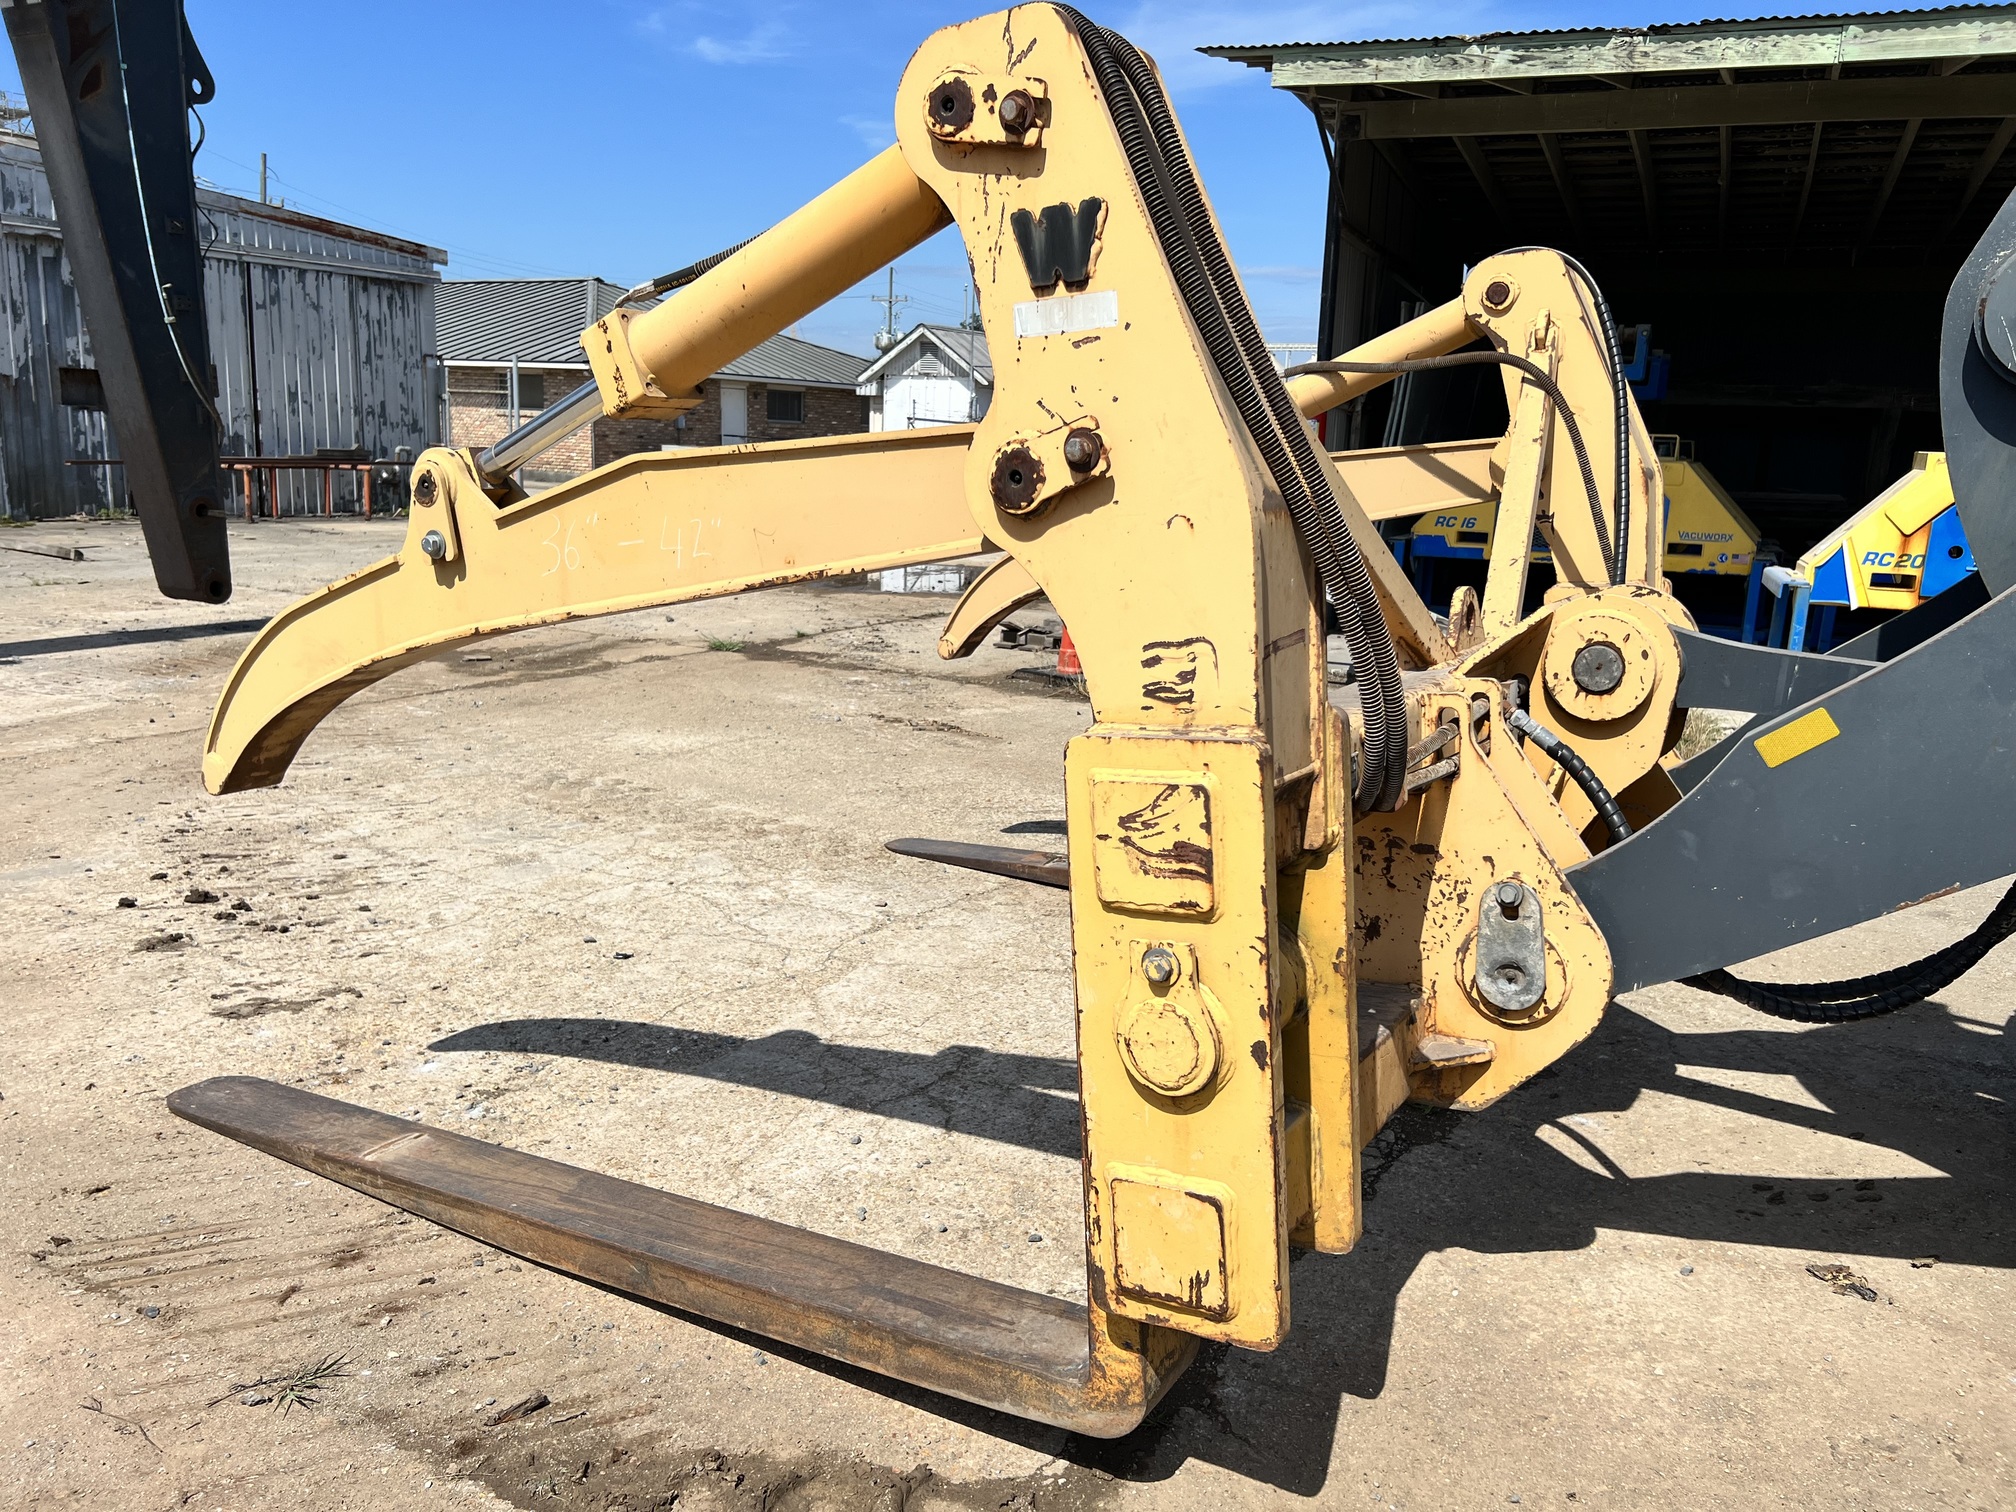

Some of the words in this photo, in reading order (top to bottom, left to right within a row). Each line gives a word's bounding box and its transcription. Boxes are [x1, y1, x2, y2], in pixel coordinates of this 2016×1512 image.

[1434, 515, 1458, 528] RC
[1460, 517, 1478, 529] 16
[1678, 530, 1734, 542] VACUWORX
[1861, 551, 1895, 567] RC
[1893, 553, 1926, 569] 20
